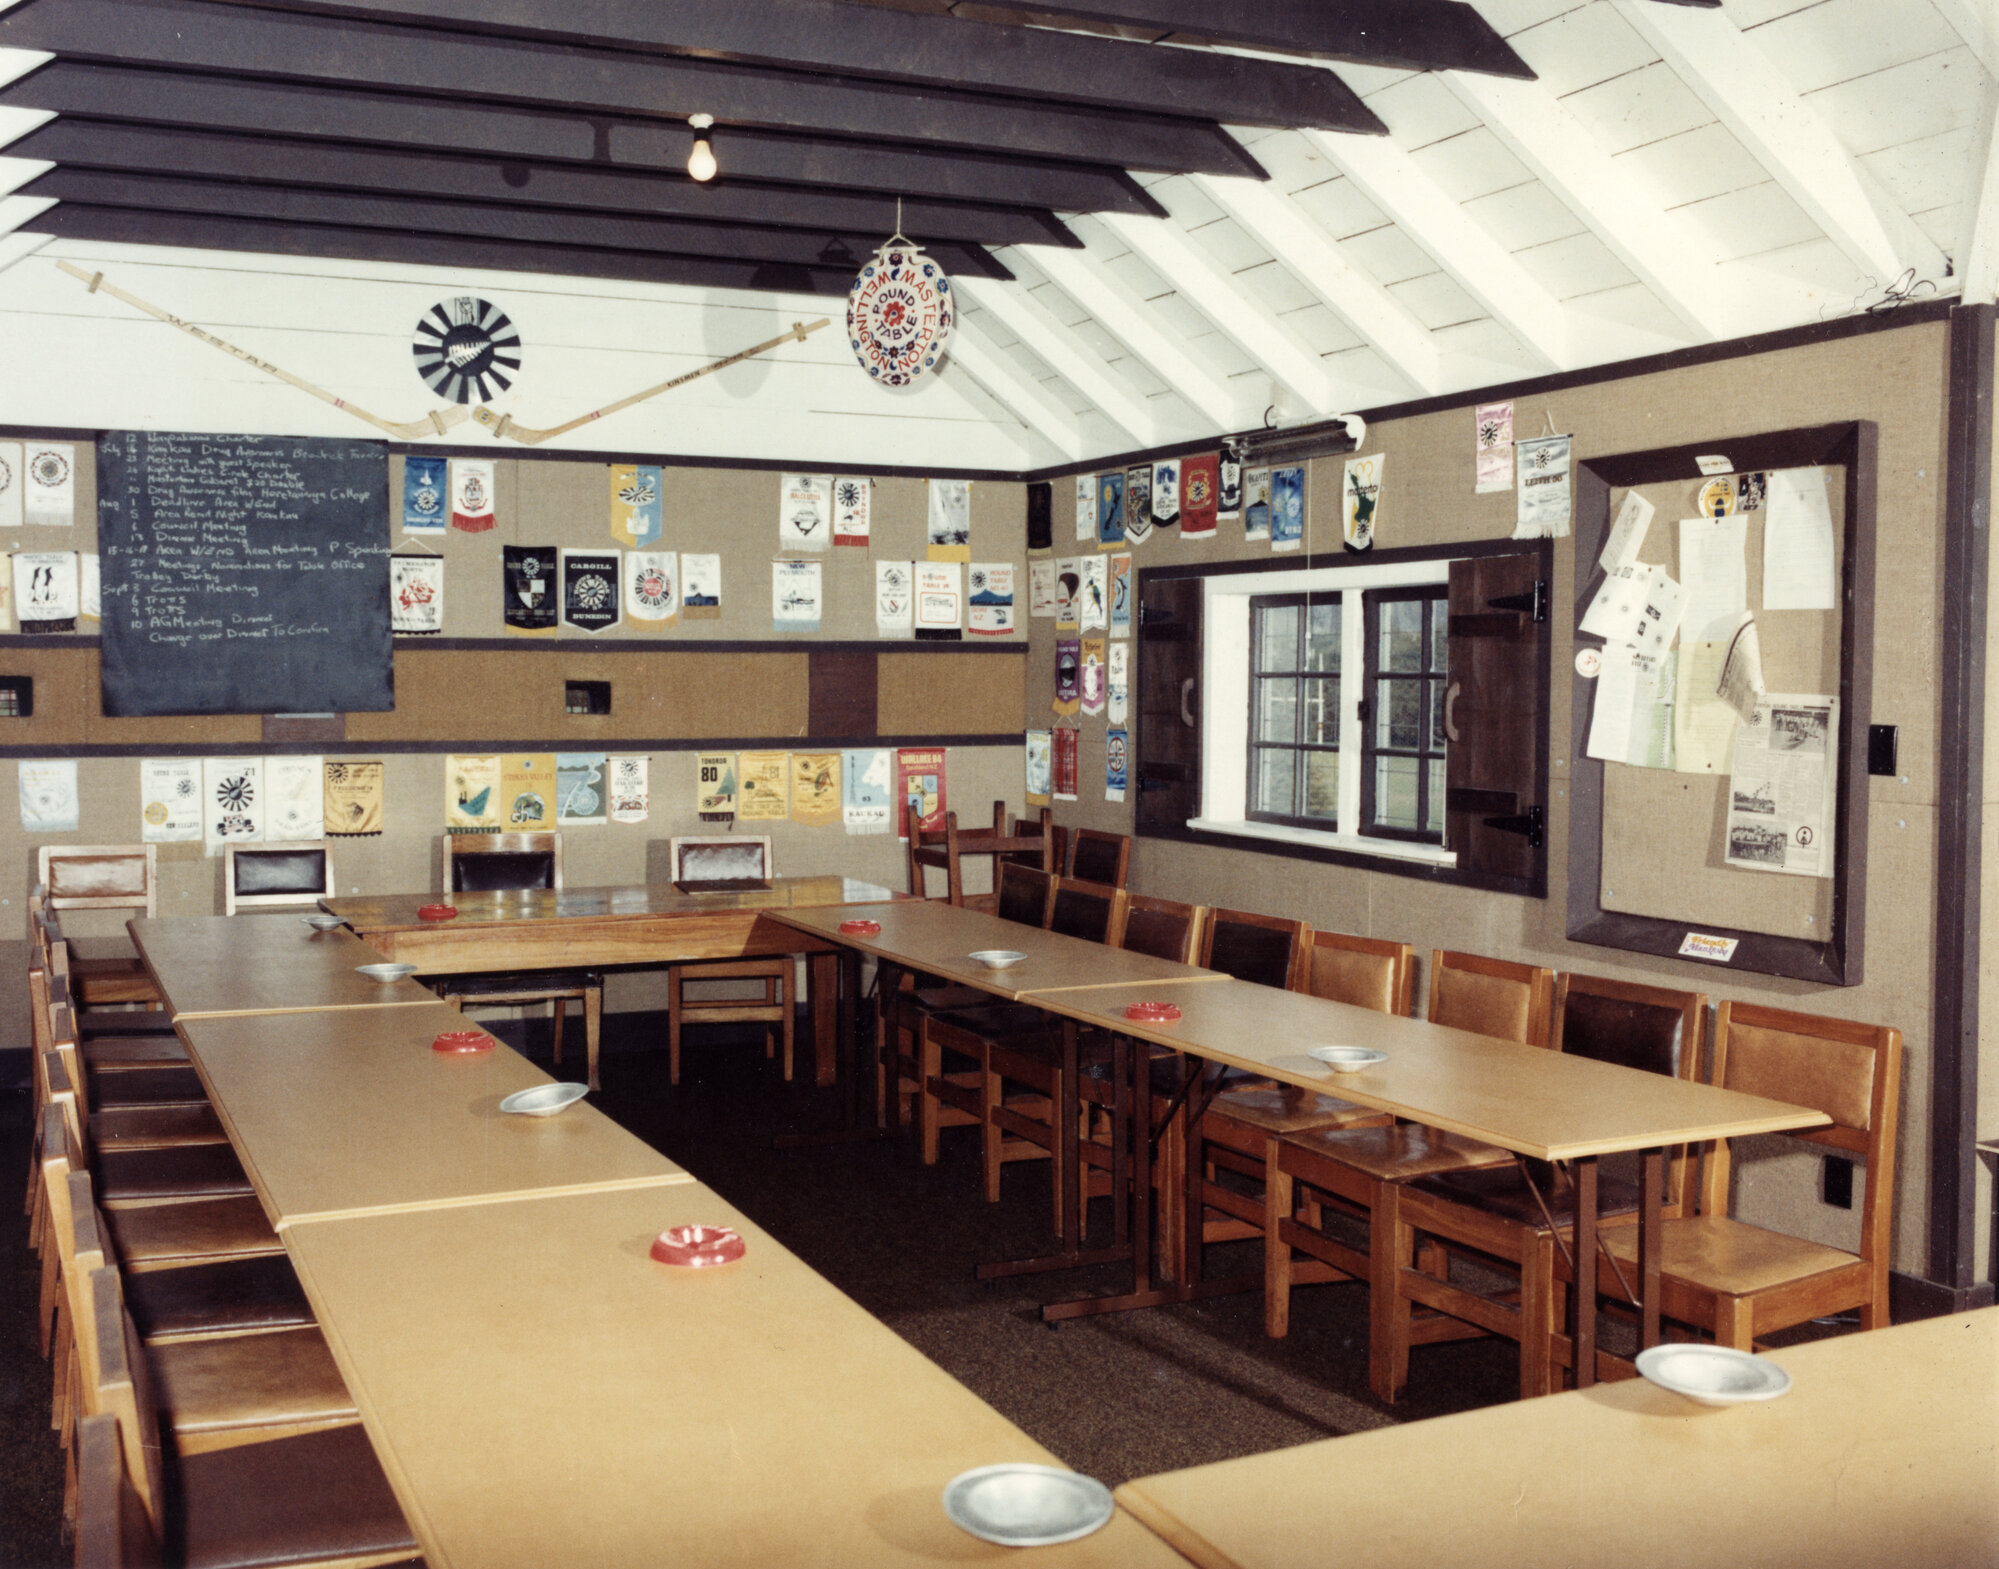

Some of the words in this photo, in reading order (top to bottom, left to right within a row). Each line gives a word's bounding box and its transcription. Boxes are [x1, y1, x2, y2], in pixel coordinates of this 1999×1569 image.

[872, 288, 915, 314] ROUND
[856, 271, 891, 370] WELLINGTON
[876, 315, 918, 340] TABLE
[898, 269, 937, 371] MASTERTON
[167, 314, 278, 373] WESTAR
[202, 444, 231, 457] Drug
[147, 456, 189, 468] Meeting
[257, 470, 300, 480] Charter
[147, 485, 174, 498] Drug
[330, 488, 370, 503] College
[151, 497, 206, 507] Deadline
[202, 522, 247, 536] Meeting
[202, 533, 248, 549] Meeting
[206, 583, 259, 597] Meeting
[701, 766, 718, 782] 80
